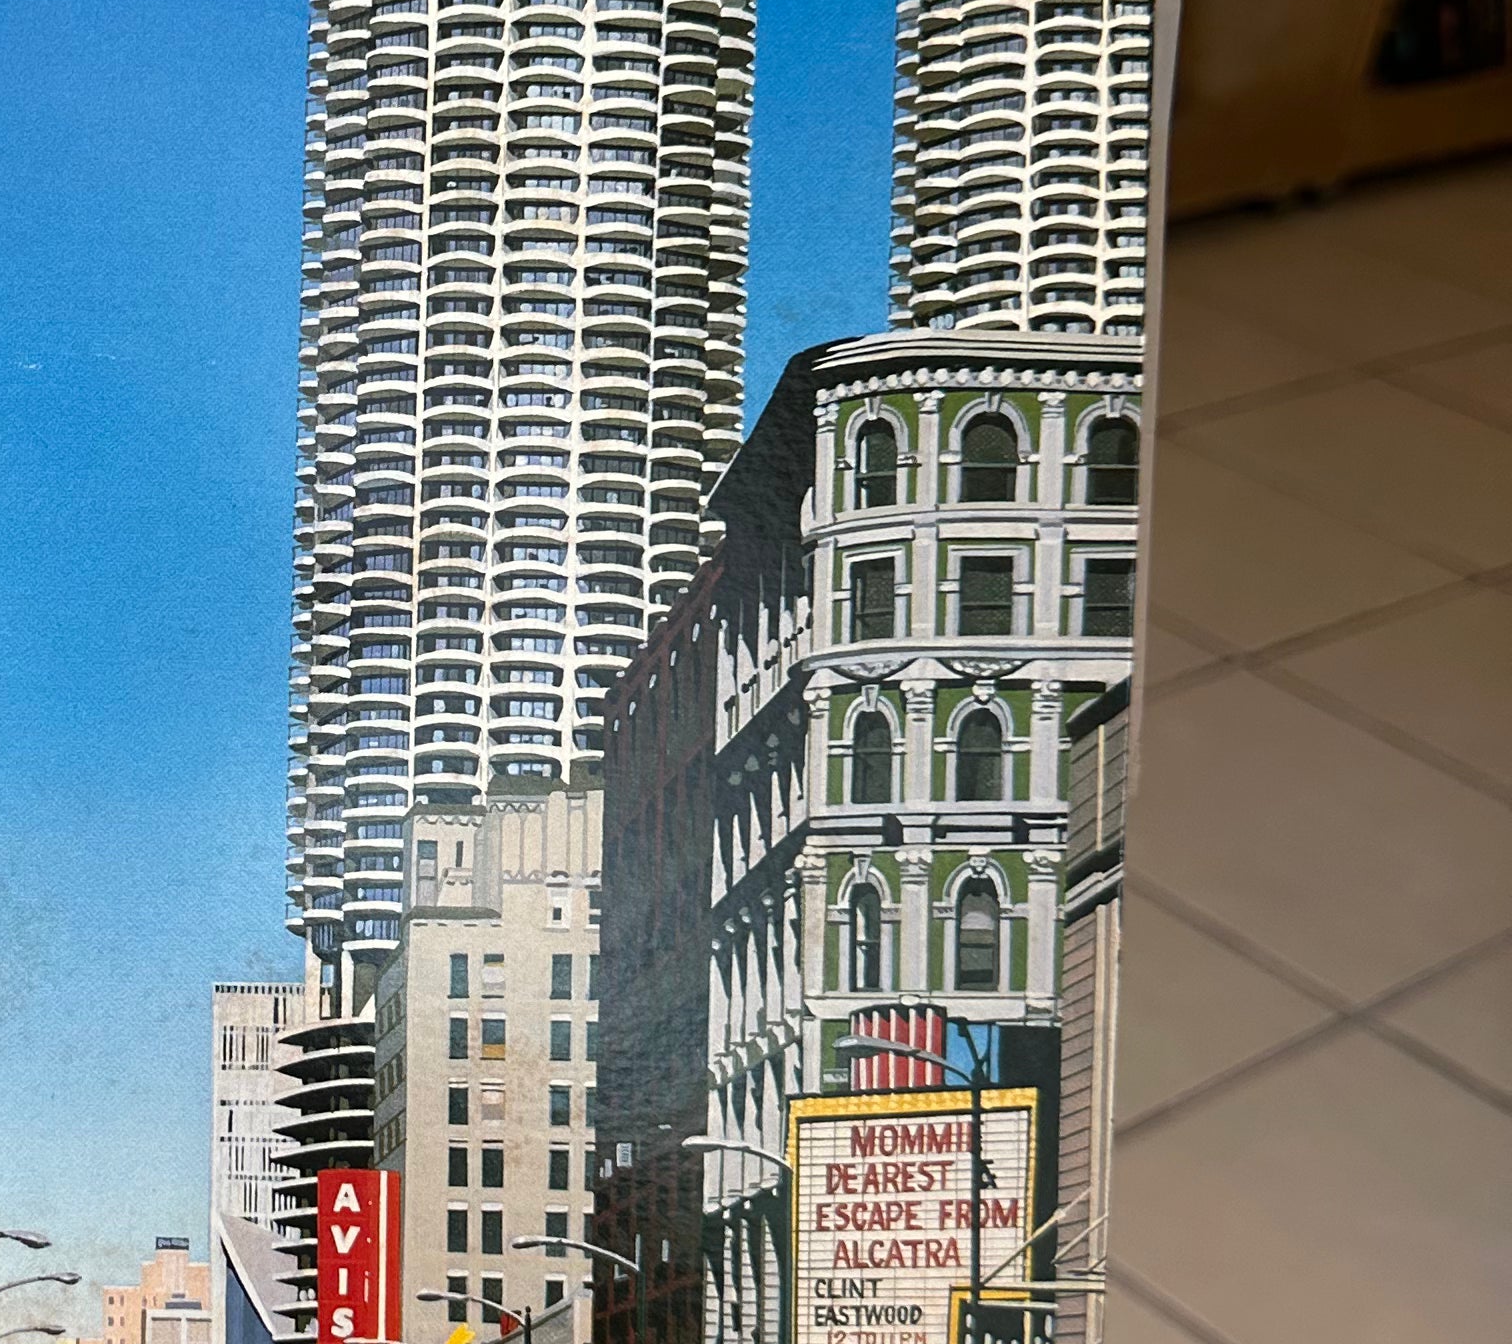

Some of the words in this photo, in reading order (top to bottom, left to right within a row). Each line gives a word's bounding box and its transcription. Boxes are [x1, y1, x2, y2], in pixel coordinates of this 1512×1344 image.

[825, 1160, 955, 1196] DEAREST
[814, 1200, 923, 1233] ESCAPE
[938, 1197, 1020, 1232] FROM
[330, 1182, 363, 1340] AVIS
[813, 1277, 884, 1300] CLINT
[813, 1304, 924, 1328] EASTWOOD
